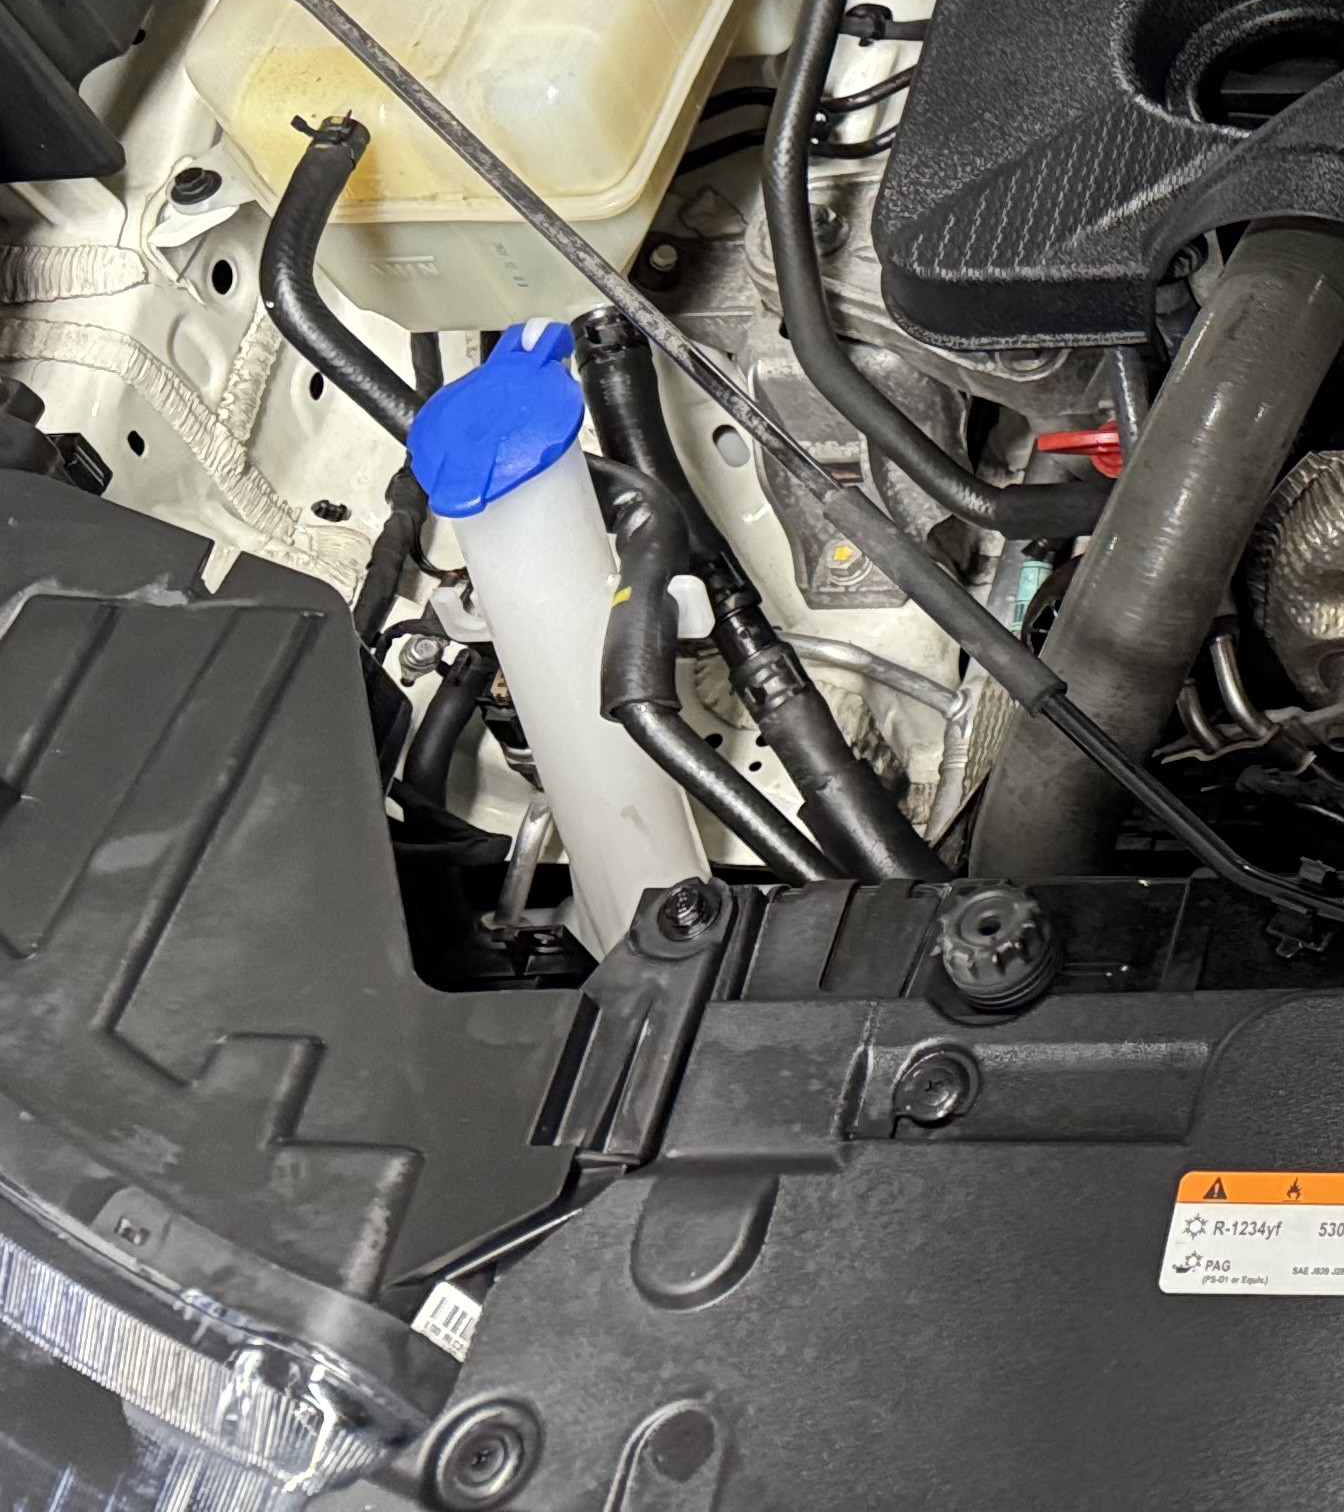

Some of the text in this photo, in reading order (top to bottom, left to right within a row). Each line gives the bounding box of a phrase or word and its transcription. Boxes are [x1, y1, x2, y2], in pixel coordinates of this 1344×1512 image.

[1212, 1220, 1283, 1241] R-1234yf
[1204, 1259, 1231, 1273] PAG
[1292, 1266, 1309, 1276] SAE
